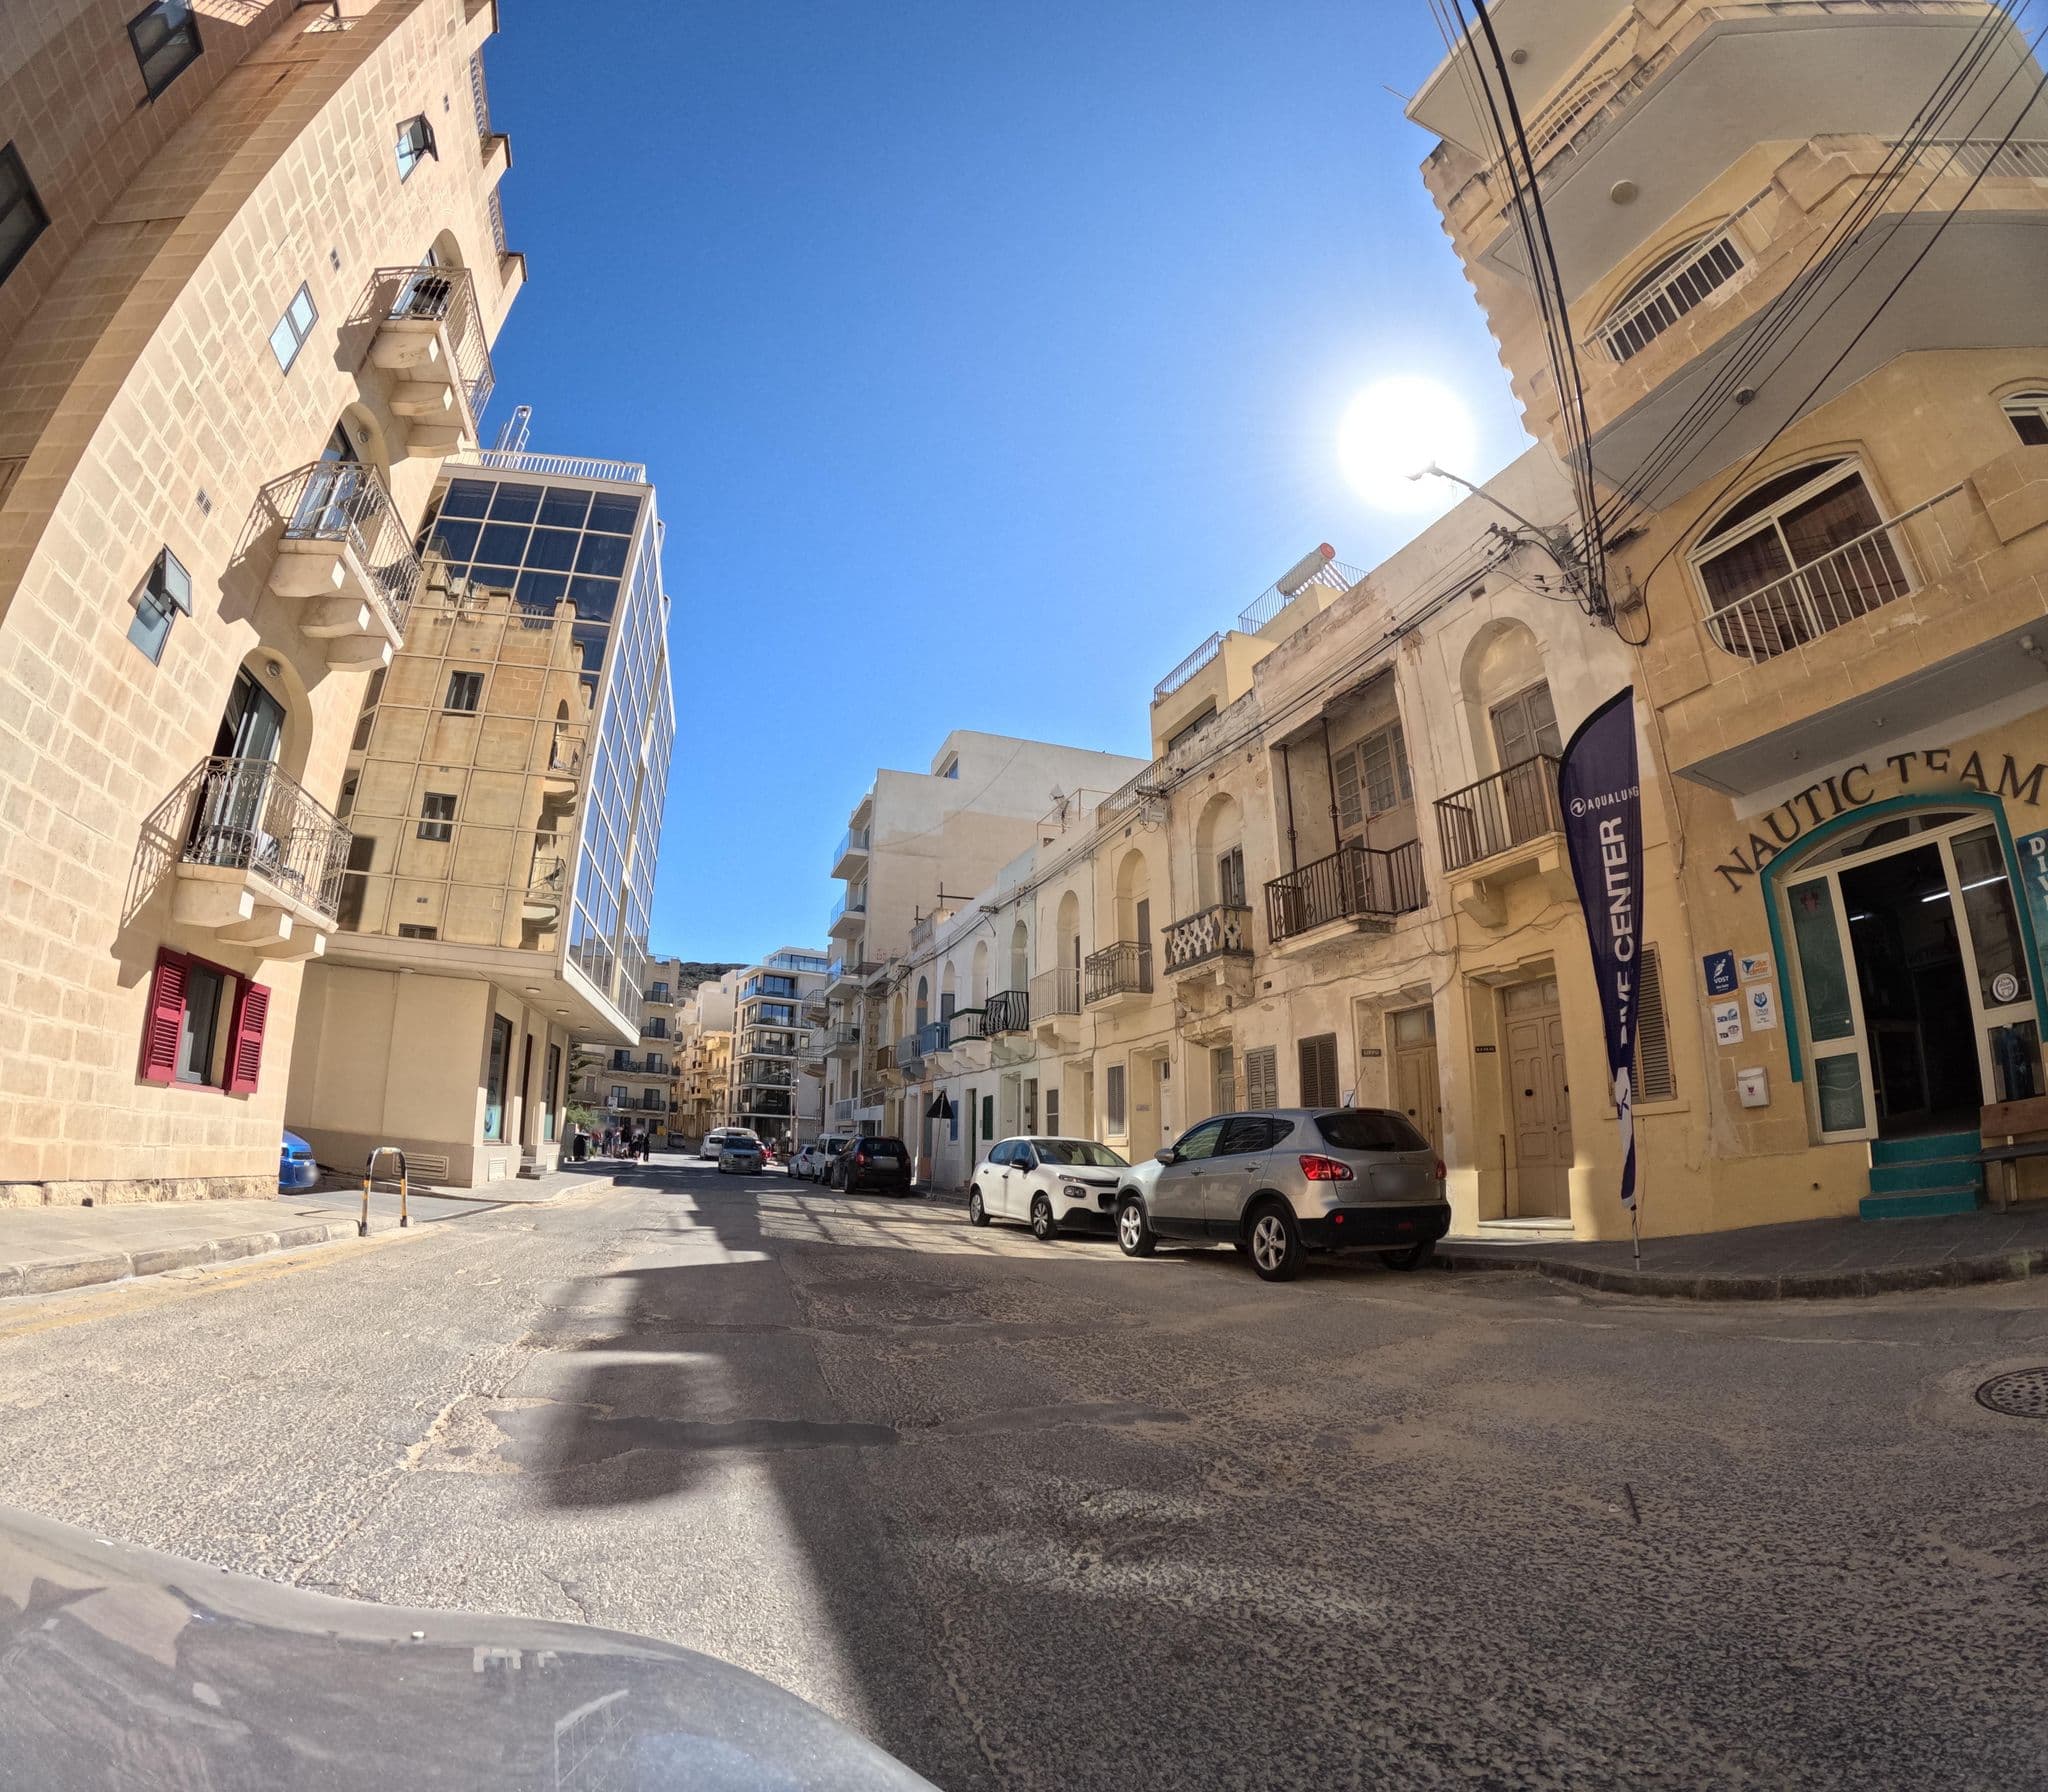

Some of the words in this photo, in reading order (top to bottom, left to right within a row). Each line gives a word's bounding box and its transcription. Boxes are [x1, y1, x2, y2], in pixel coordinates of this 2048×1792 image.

[1587, 785, 1640, 811] AQUALUNG
[1714, 763, 1875, 893] NAUTIC
[1887, 749, 2048, 807] TEAM
[1599, 816, 1635, 962] CENTER
